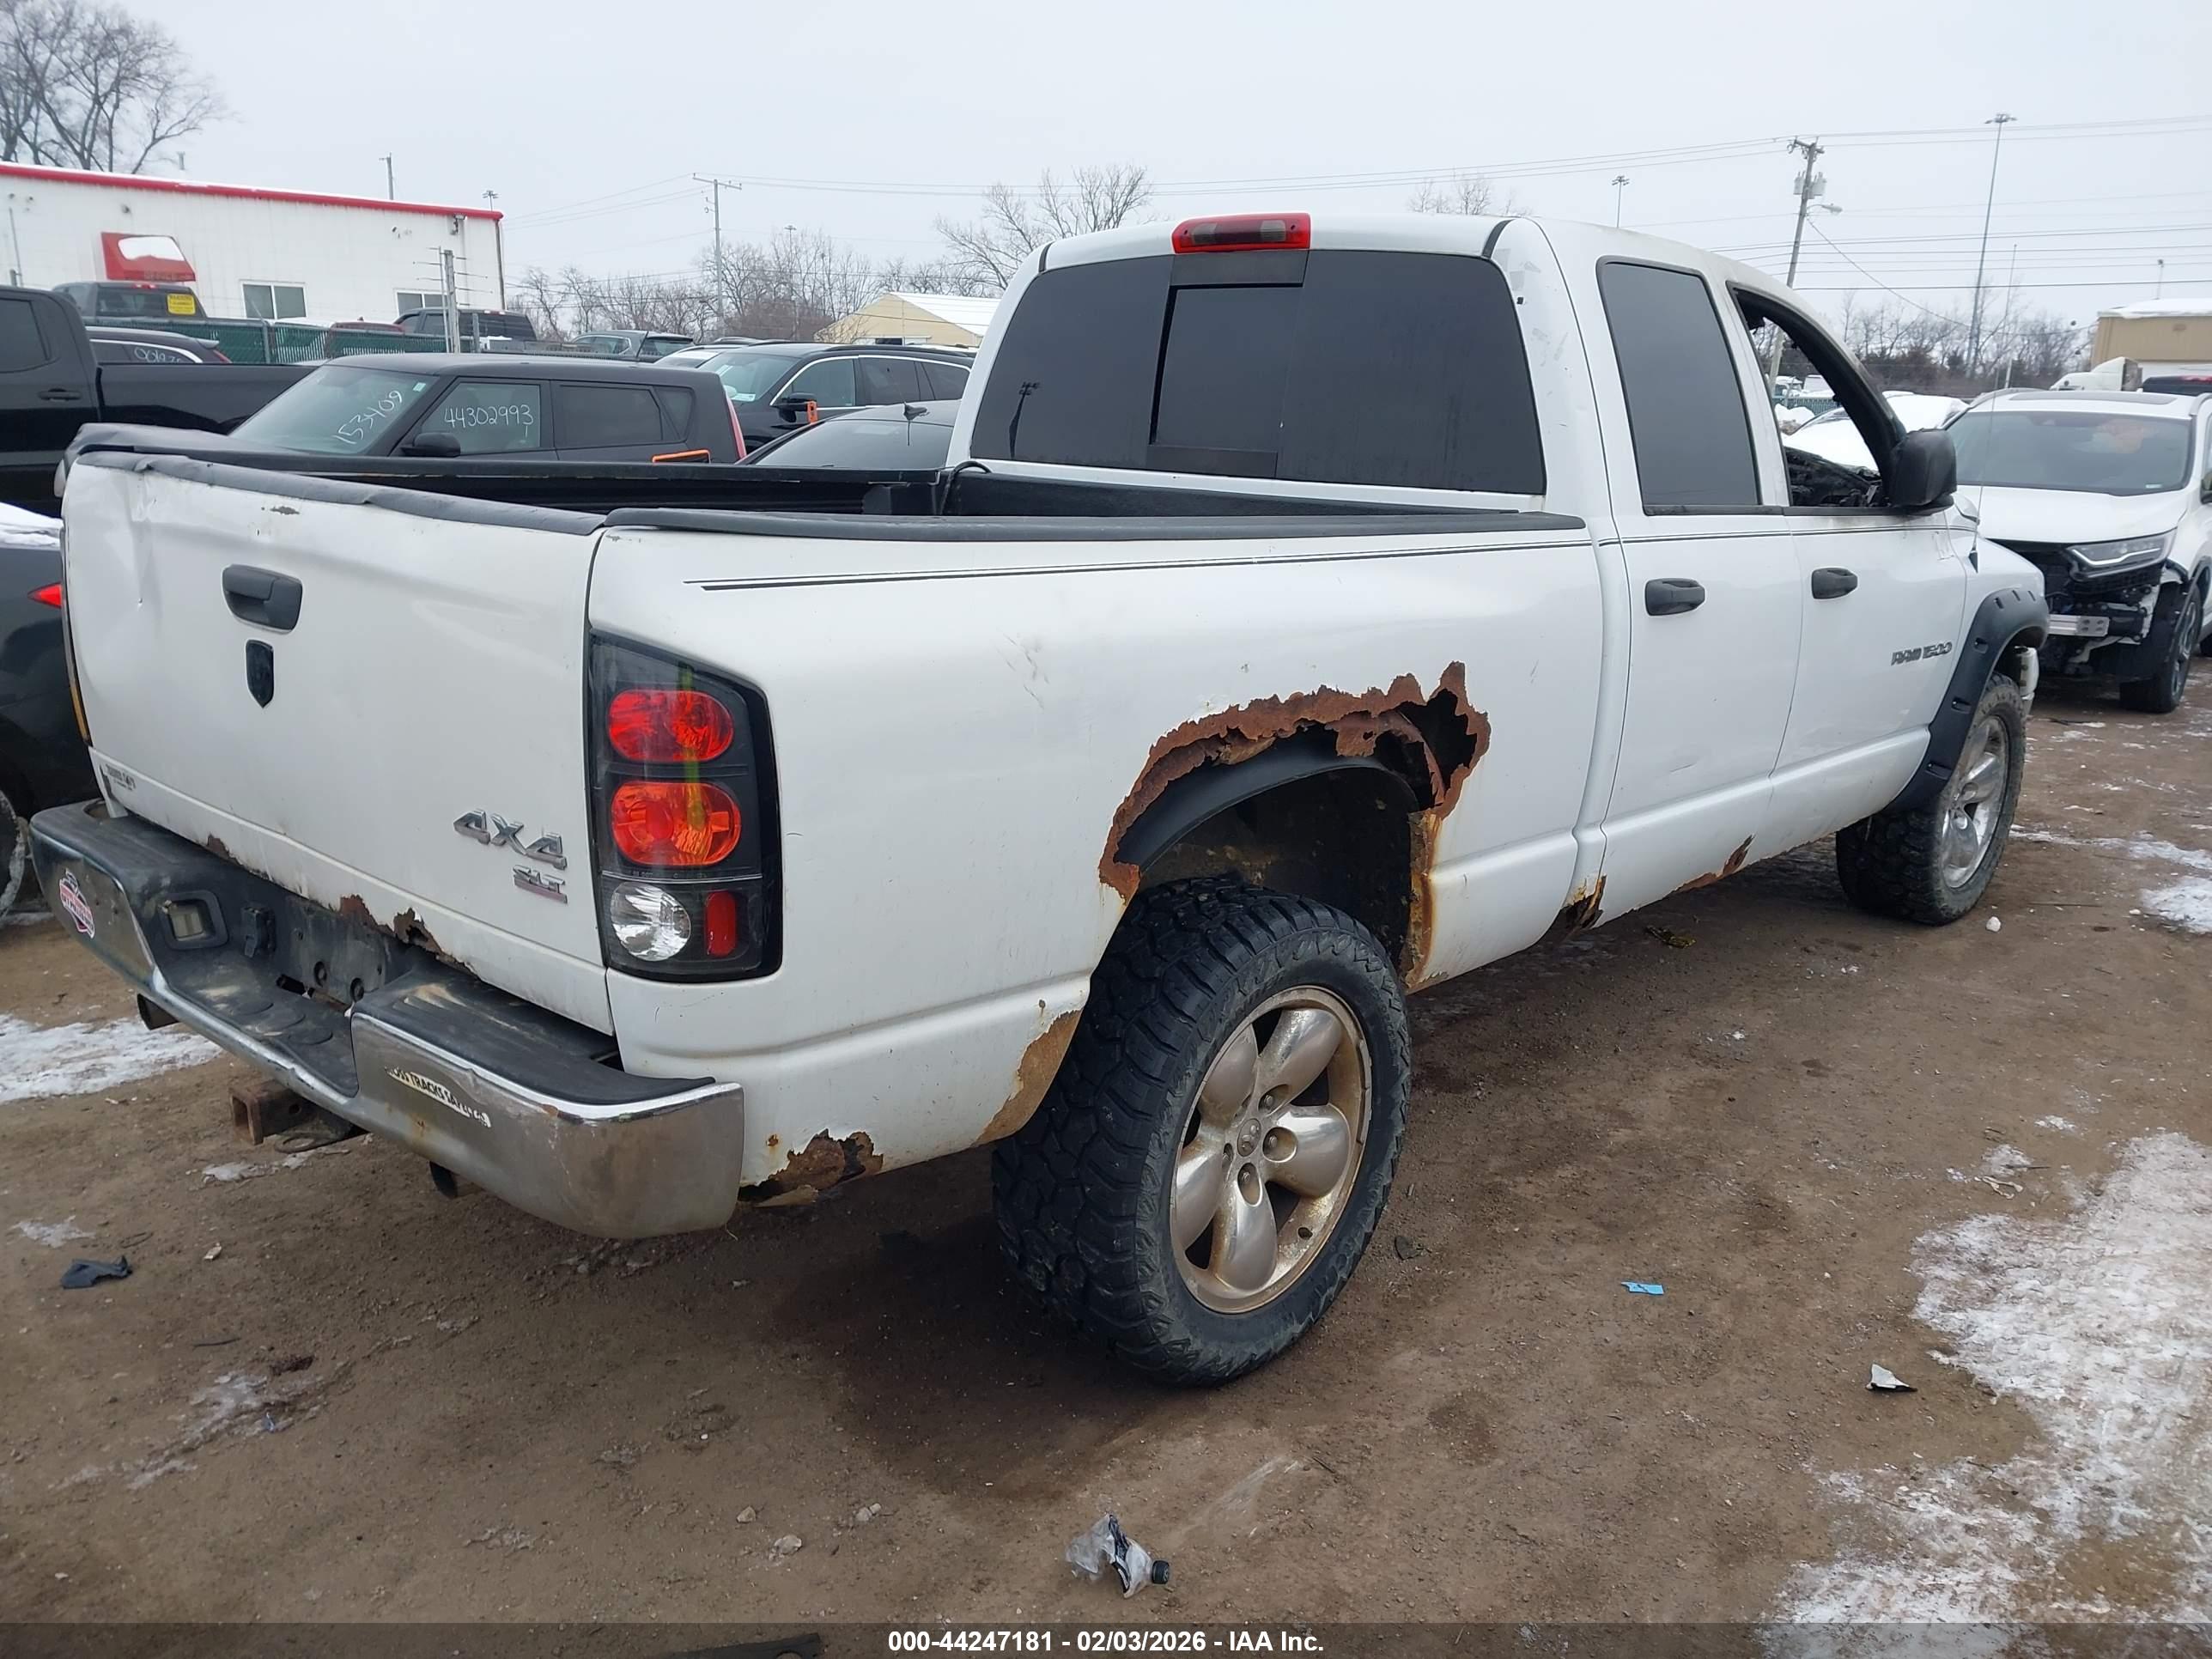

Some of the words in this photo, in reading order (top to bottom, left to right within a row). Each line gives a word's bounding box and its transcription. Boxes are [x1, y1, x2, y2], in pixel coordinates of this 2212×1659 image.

[444, 404, 534, 428] 44302993
[1891, 647, 1923, 665] RAM
[1923, 641, 1953, 659] 1500
[513, 865, 568, 904] SLT
